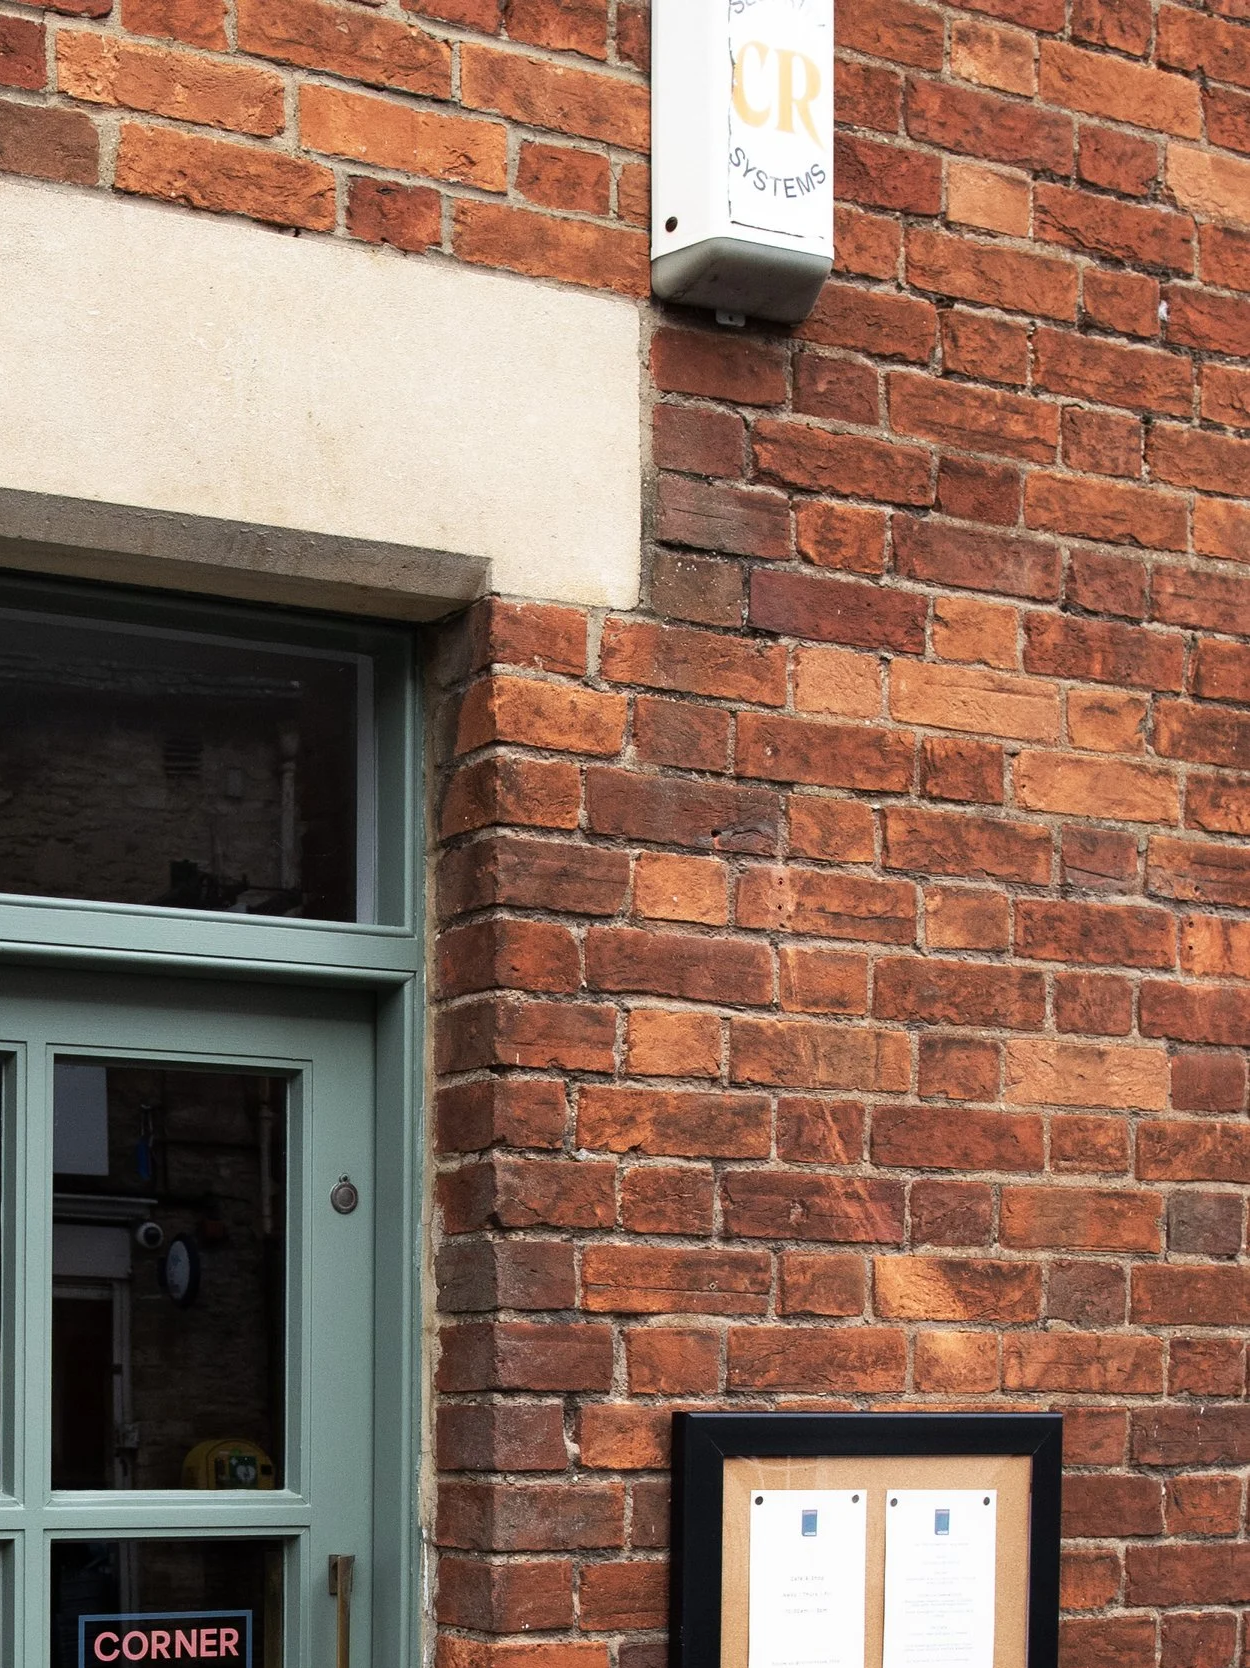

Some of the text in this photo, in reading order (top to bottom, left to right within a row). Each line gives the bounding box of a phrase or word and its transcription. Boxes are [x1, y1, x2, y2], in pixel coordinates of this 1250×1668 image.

[731, 40, 825, 150] CR
[729, 147, 826, 199] SYSTEMS
[93, 1627, 240, 1662] CORNER
